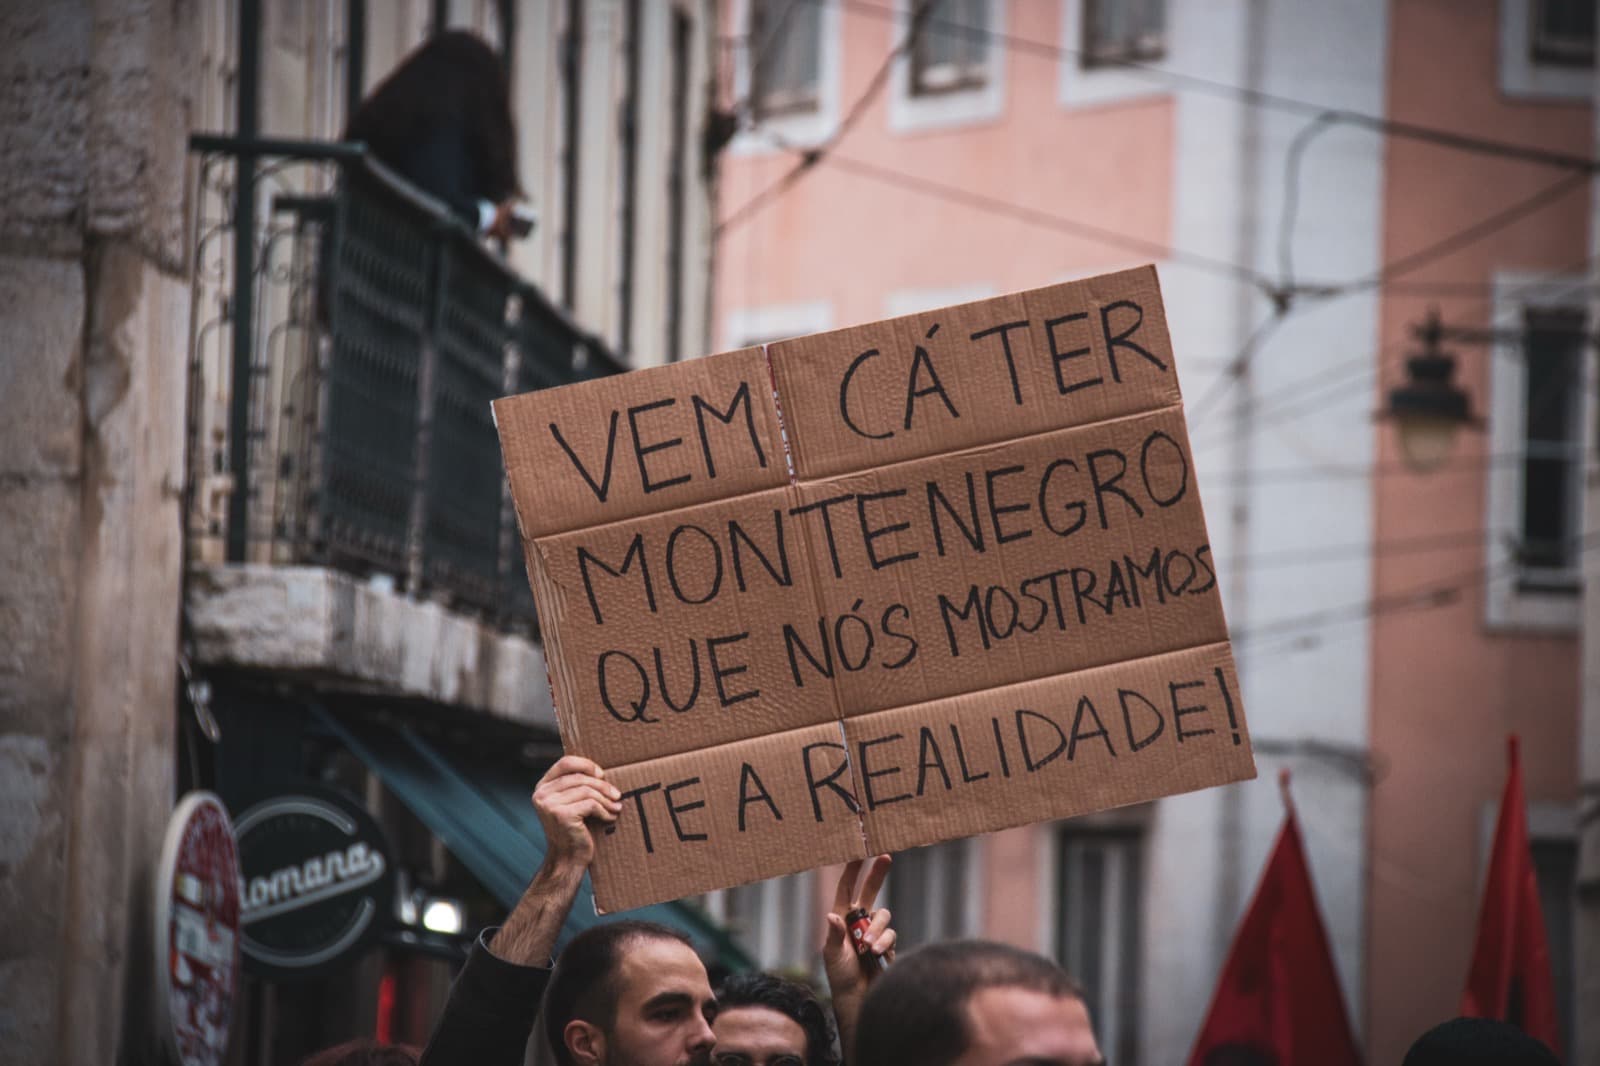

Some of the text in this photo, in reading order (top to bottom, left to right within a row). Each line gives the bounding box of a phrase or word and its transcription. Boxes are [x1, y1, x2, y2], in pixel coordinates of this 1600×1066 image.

[549, 300, 1168, 502] VEM CÁ TER
[577, 430, 1188, 625] MONTENEGRO
[598, 544, 1216, 723] QUE NÓS MOSTRAMOS
[738, 762, 783, 832] A
[802, 667, 1241, 822] REALIDADE!
